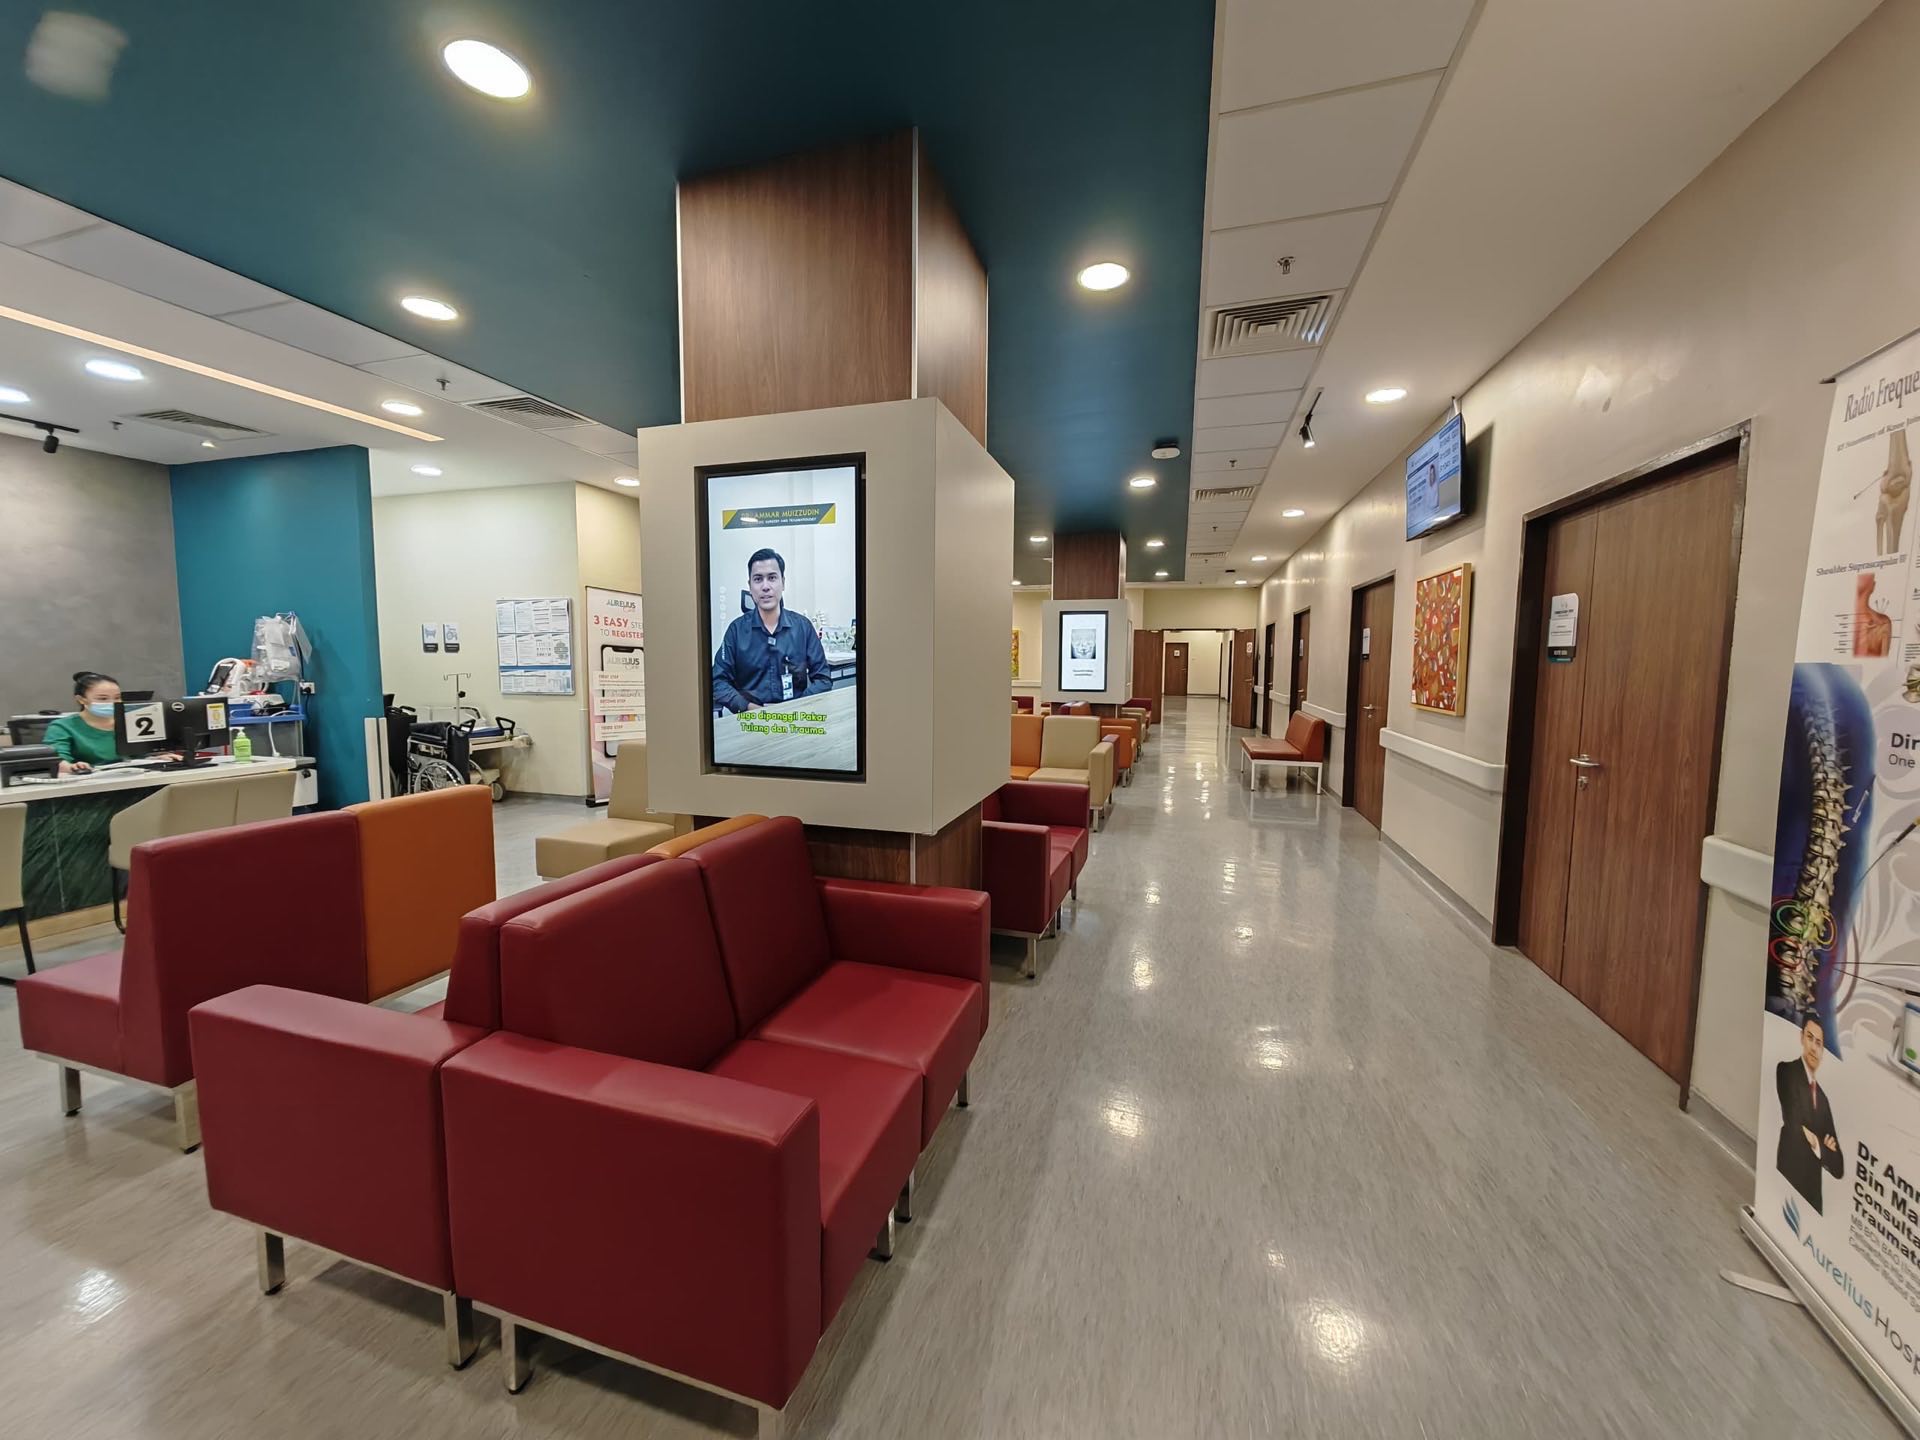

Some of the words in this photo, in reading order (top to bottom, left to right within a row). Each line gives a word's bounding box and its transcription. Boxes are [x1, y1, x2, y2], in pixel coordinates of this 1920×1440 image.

[1844, 384, 1875, 423] Radio
[755, 510, 780, 519] AMMAR
[606, 599, 636, 609] AURELIUS
[593, 615, 600, 625] 3
[603, 616, 628, 628] EASY
[600, 628, 610, 637] TO
[757, 709, 799, 723] dipanggil
[799, 711, 828, 722] Pakar
[134, 717, 156, 737] 2
[741, 722, 770, 735] Tulang
[770, 723, 788, 734] dan
[789, 724, 827, 735] Trauma.
[1888, 753, 1916, 768] One
[1857, 1140, 1879, 1168] Dr
[1856, 1160, 1885, 1198] Bin
